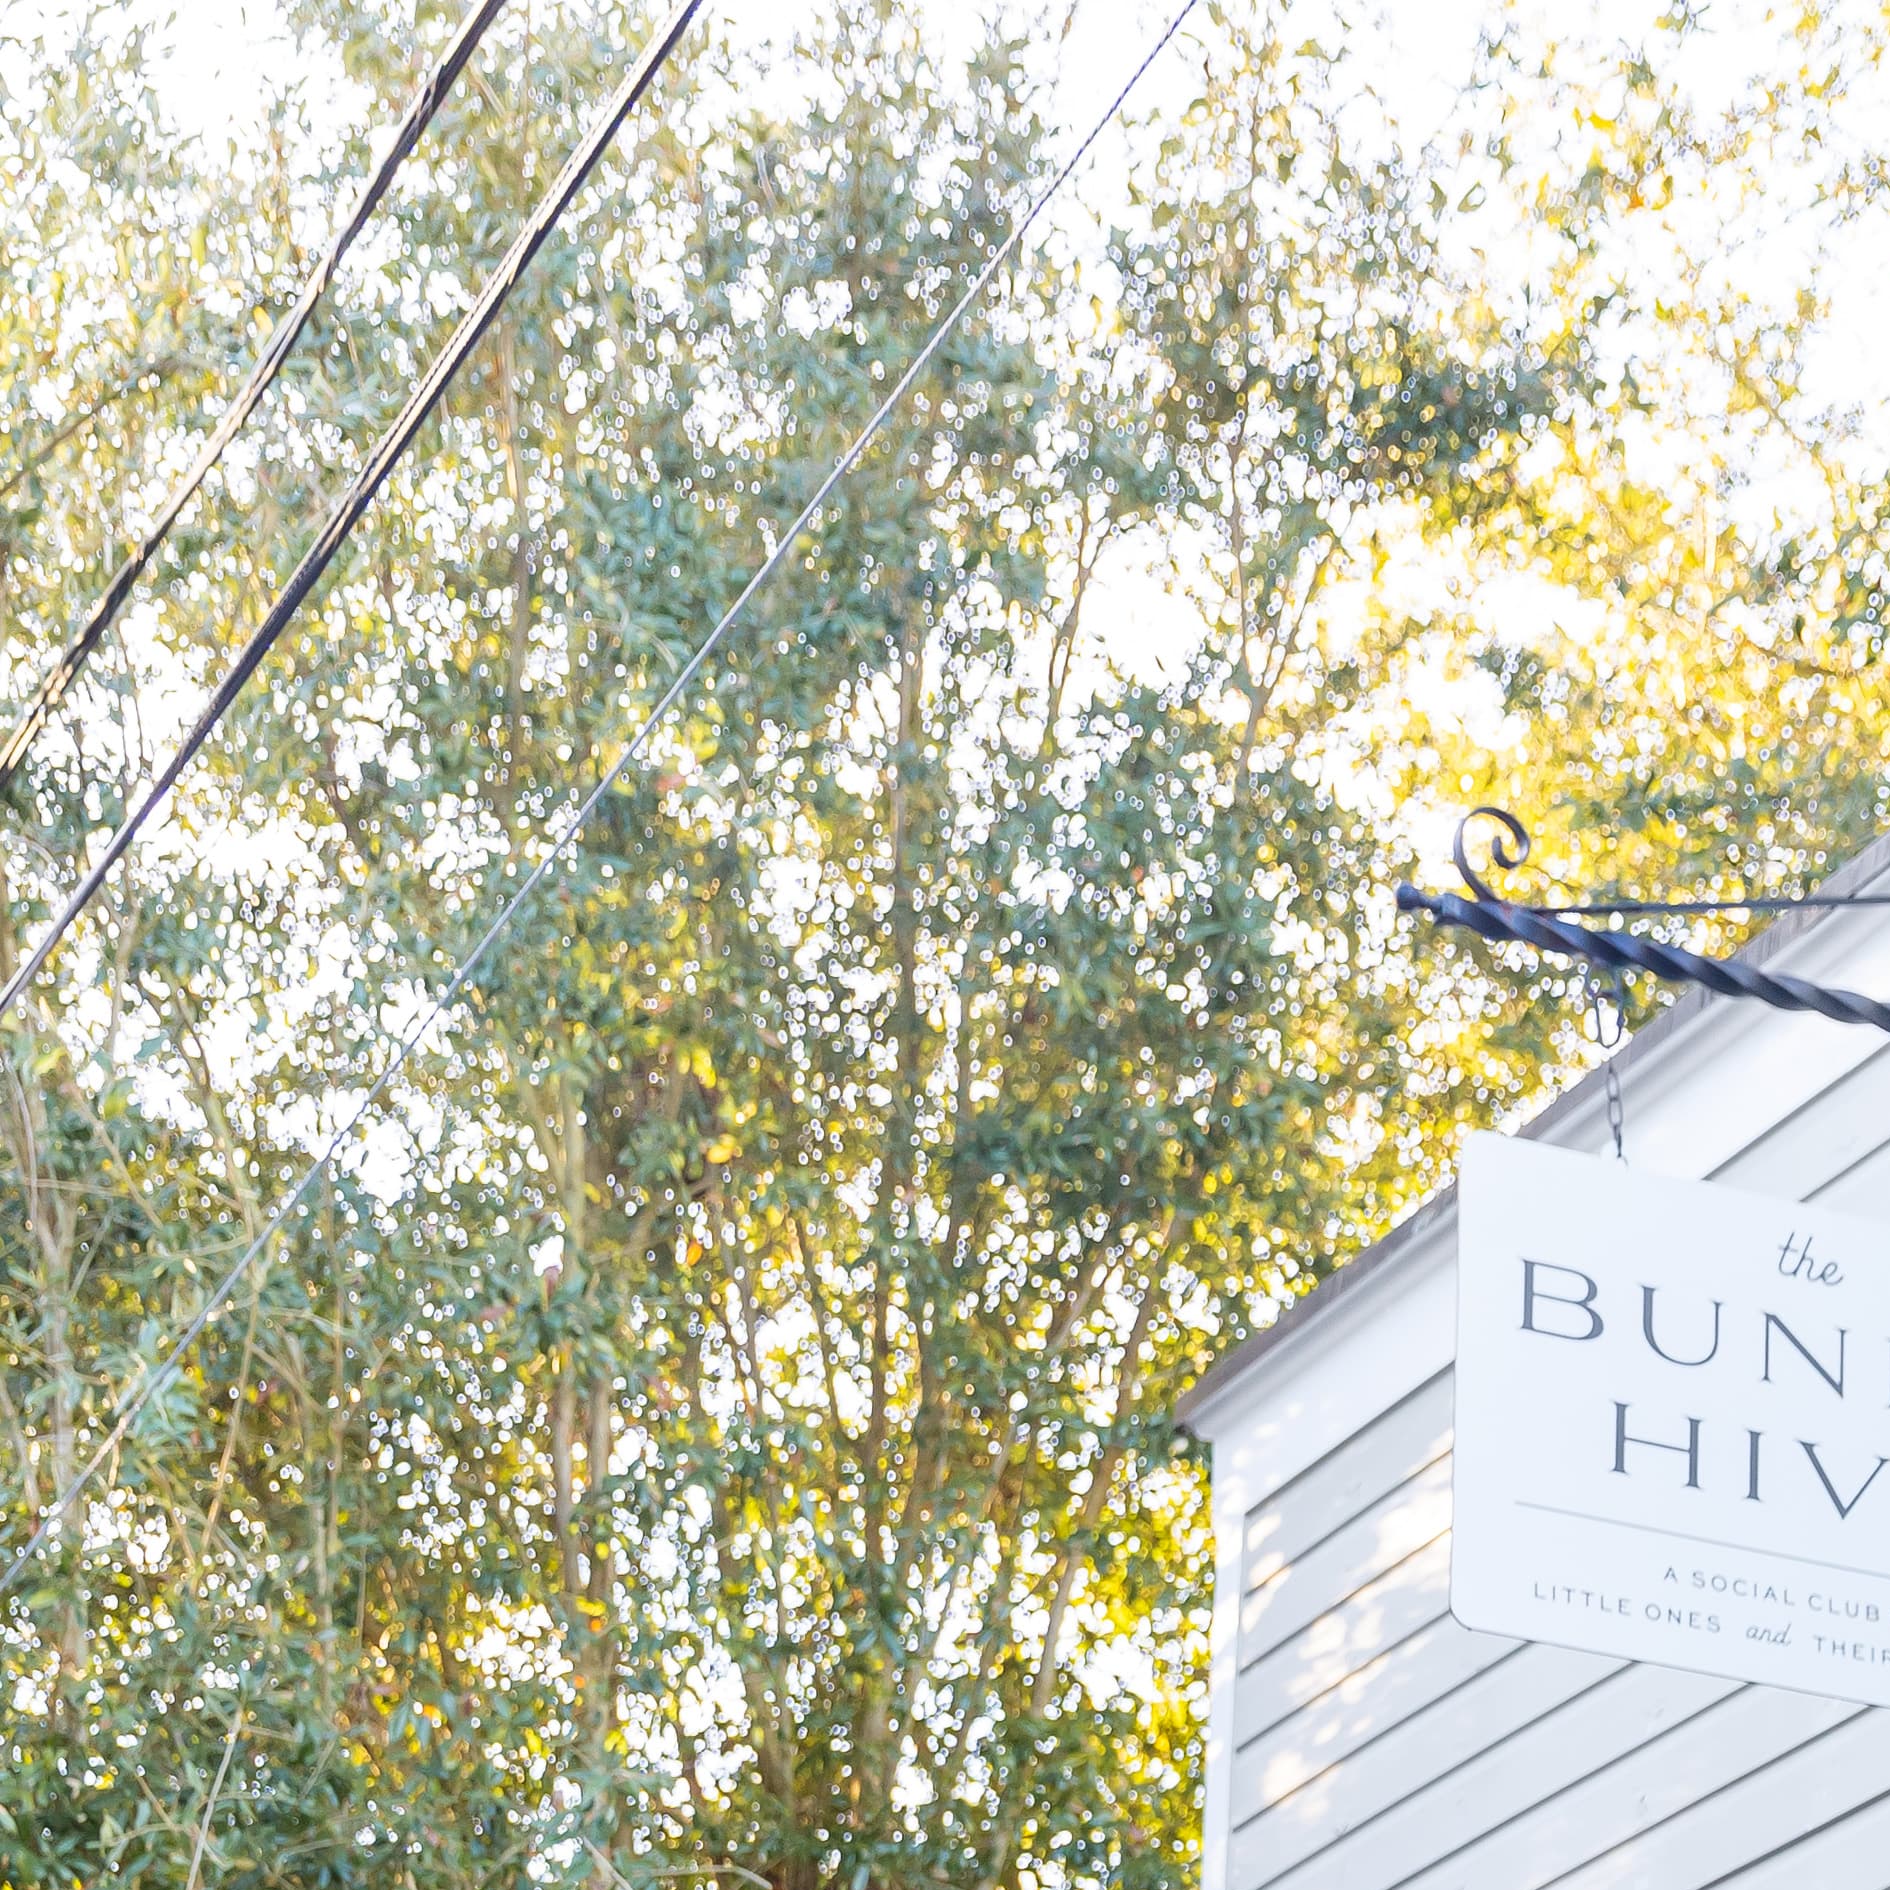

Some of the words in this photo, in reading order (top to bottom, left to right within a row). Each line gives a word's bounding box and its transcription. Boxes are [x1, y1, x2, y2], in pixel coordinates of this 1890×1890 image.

[1778, 1231, 1844, 1286] the
[1533, 1582, 1631, 1617] LITTLE
[1644, 1604, 1722, 1634] ONES
[1746, 1622, 1792, 1648] and
[1664, 1566, 1679, 1584] A
[1692, 1571, 1796, 1606] SOCIAL
[1808, 1595, 1881, 1623] CLUB
